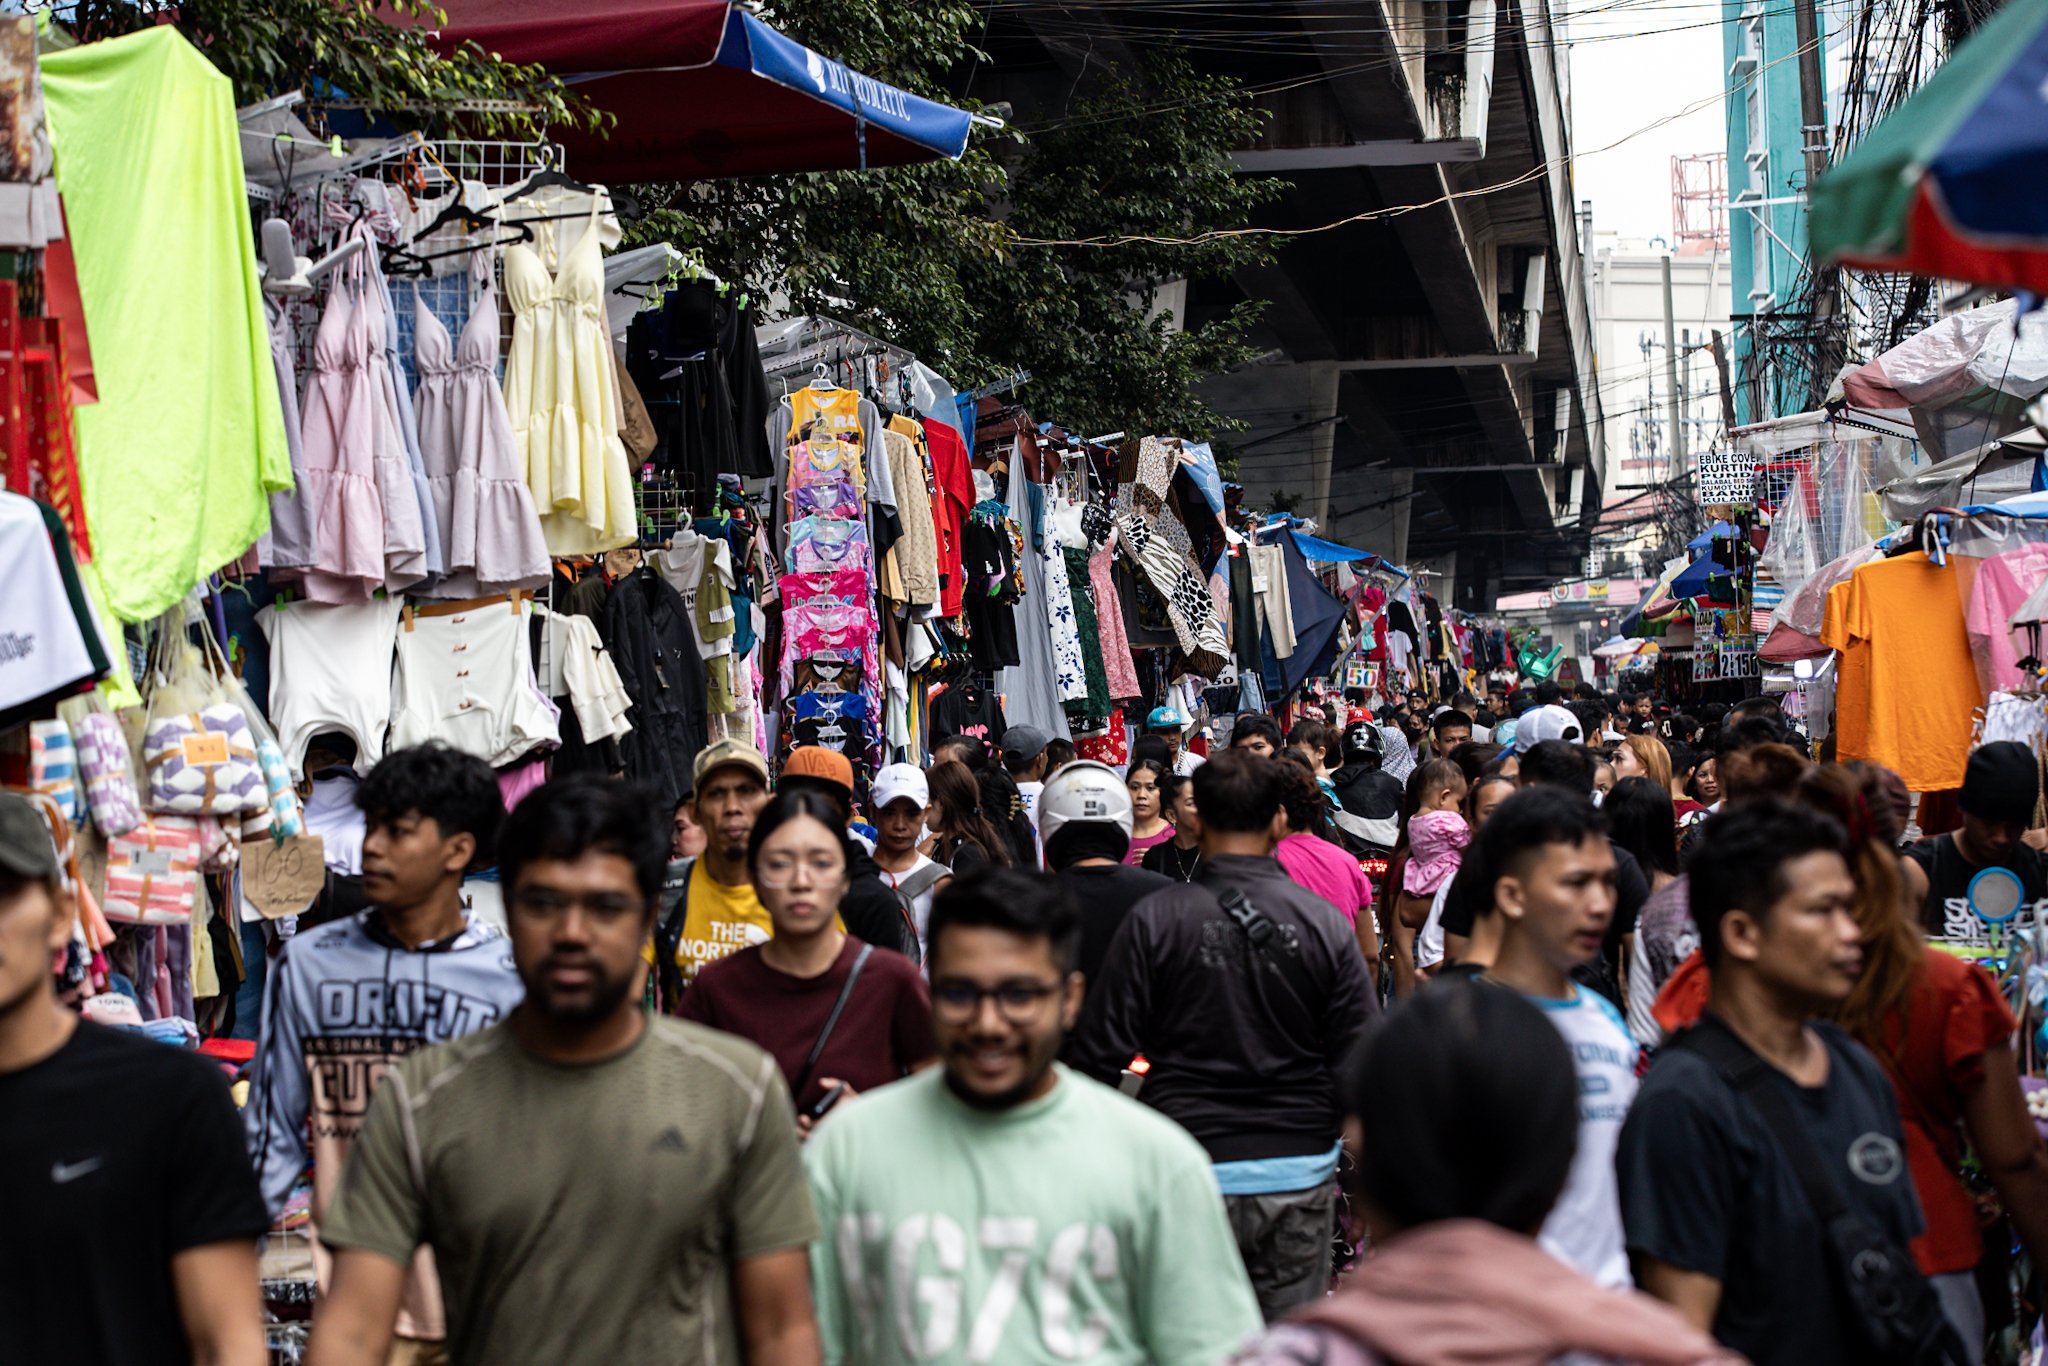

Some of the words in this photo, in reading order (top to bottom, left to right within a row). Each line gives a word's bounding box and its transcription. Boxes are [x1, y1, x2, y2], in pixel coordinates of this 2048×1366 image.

[825, 60, 910, 121] MIROMATIC
[1699, 454, 1728, 464] EBIKE
[1348, 669, 1377, 687] 50
[709, 921, 745, 943] THE
